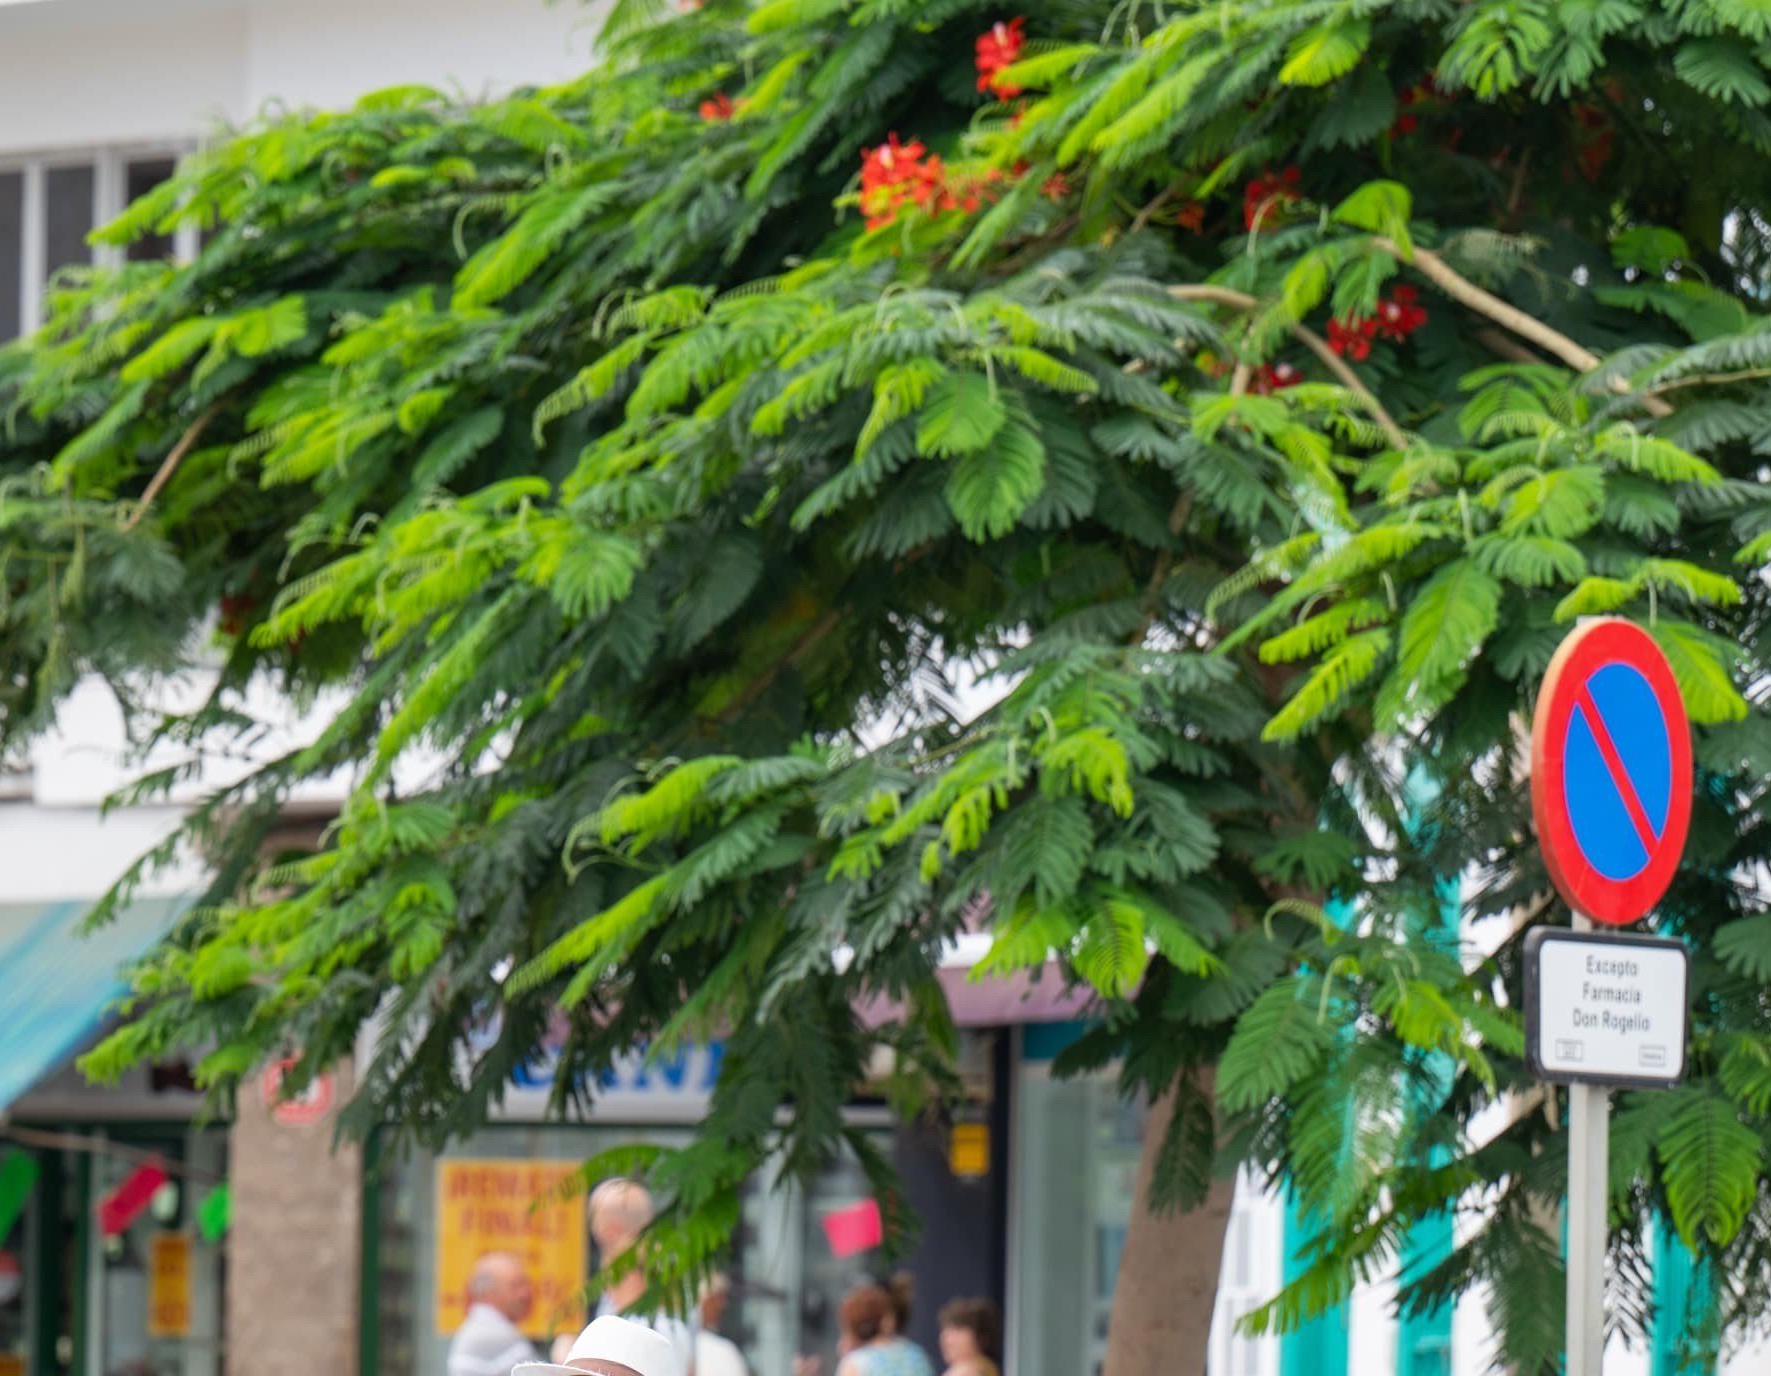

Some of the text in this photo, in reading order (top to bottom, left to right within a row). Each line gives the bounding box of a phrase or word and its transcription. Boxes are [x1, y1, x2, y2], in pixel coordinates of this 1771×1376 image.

[1586, 955, 1638, 978] Excepto
[1583, 982, 1642, 1004] Farmacia
[1573, 1008, 1651, 1035] Don Rogelio
